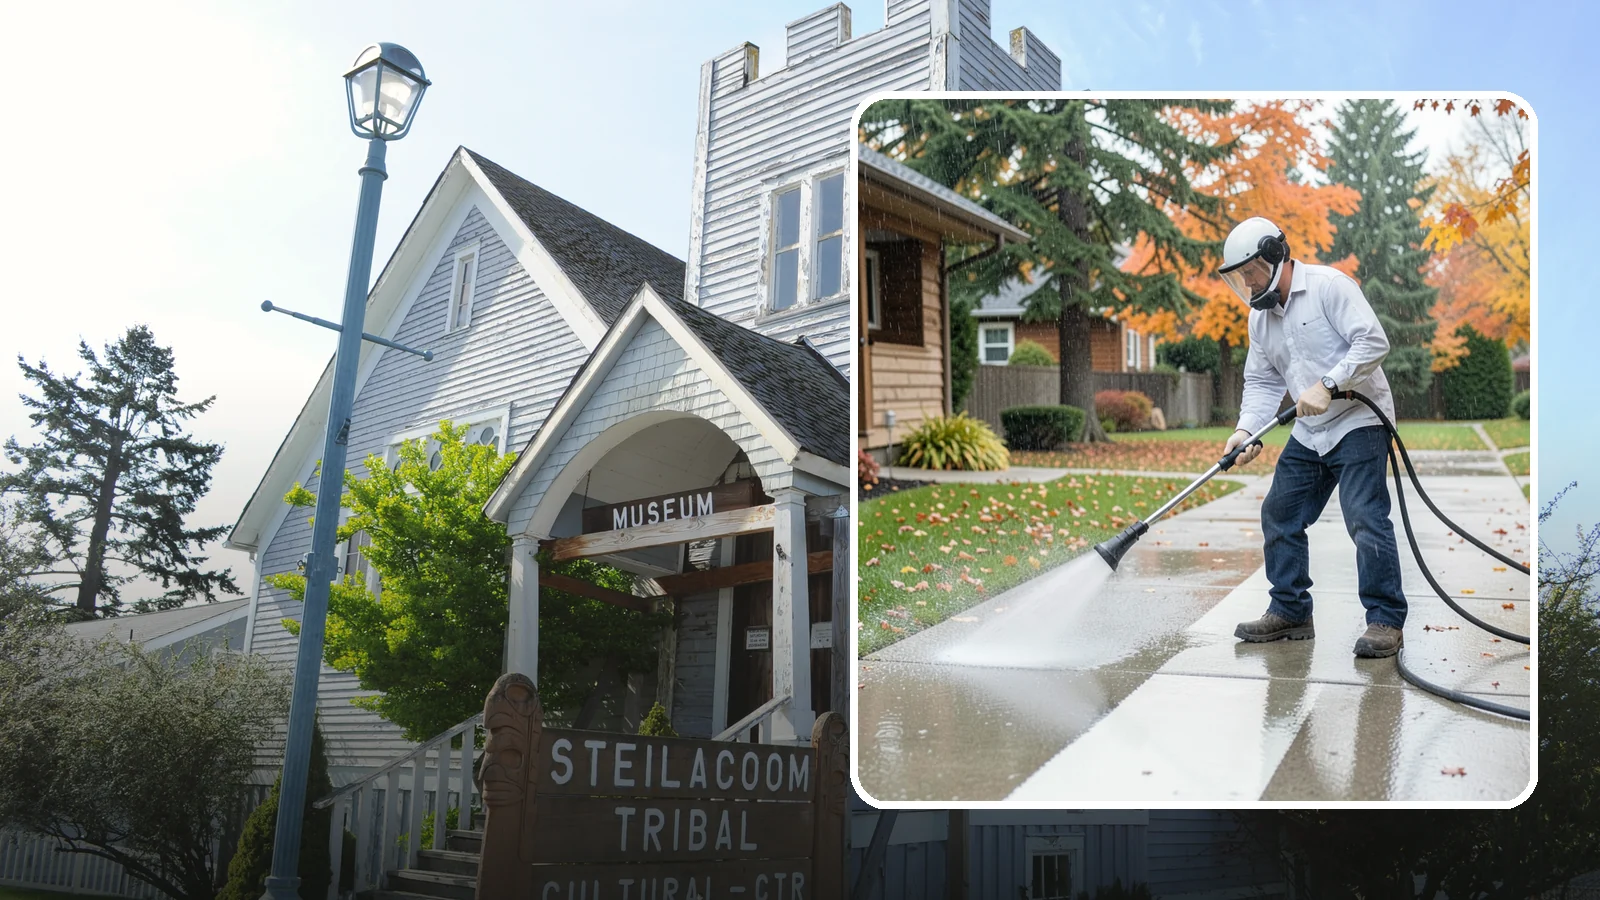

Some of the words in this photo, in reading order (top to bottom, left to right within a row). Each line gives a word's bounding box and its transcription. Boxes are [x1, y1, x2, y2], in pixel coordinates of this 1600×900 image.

[613, 492, 713, 530] MUSEUM
[551, 737, 809, 792] STEILACOOM
[615, 807, 757, 851] TRIBAL
